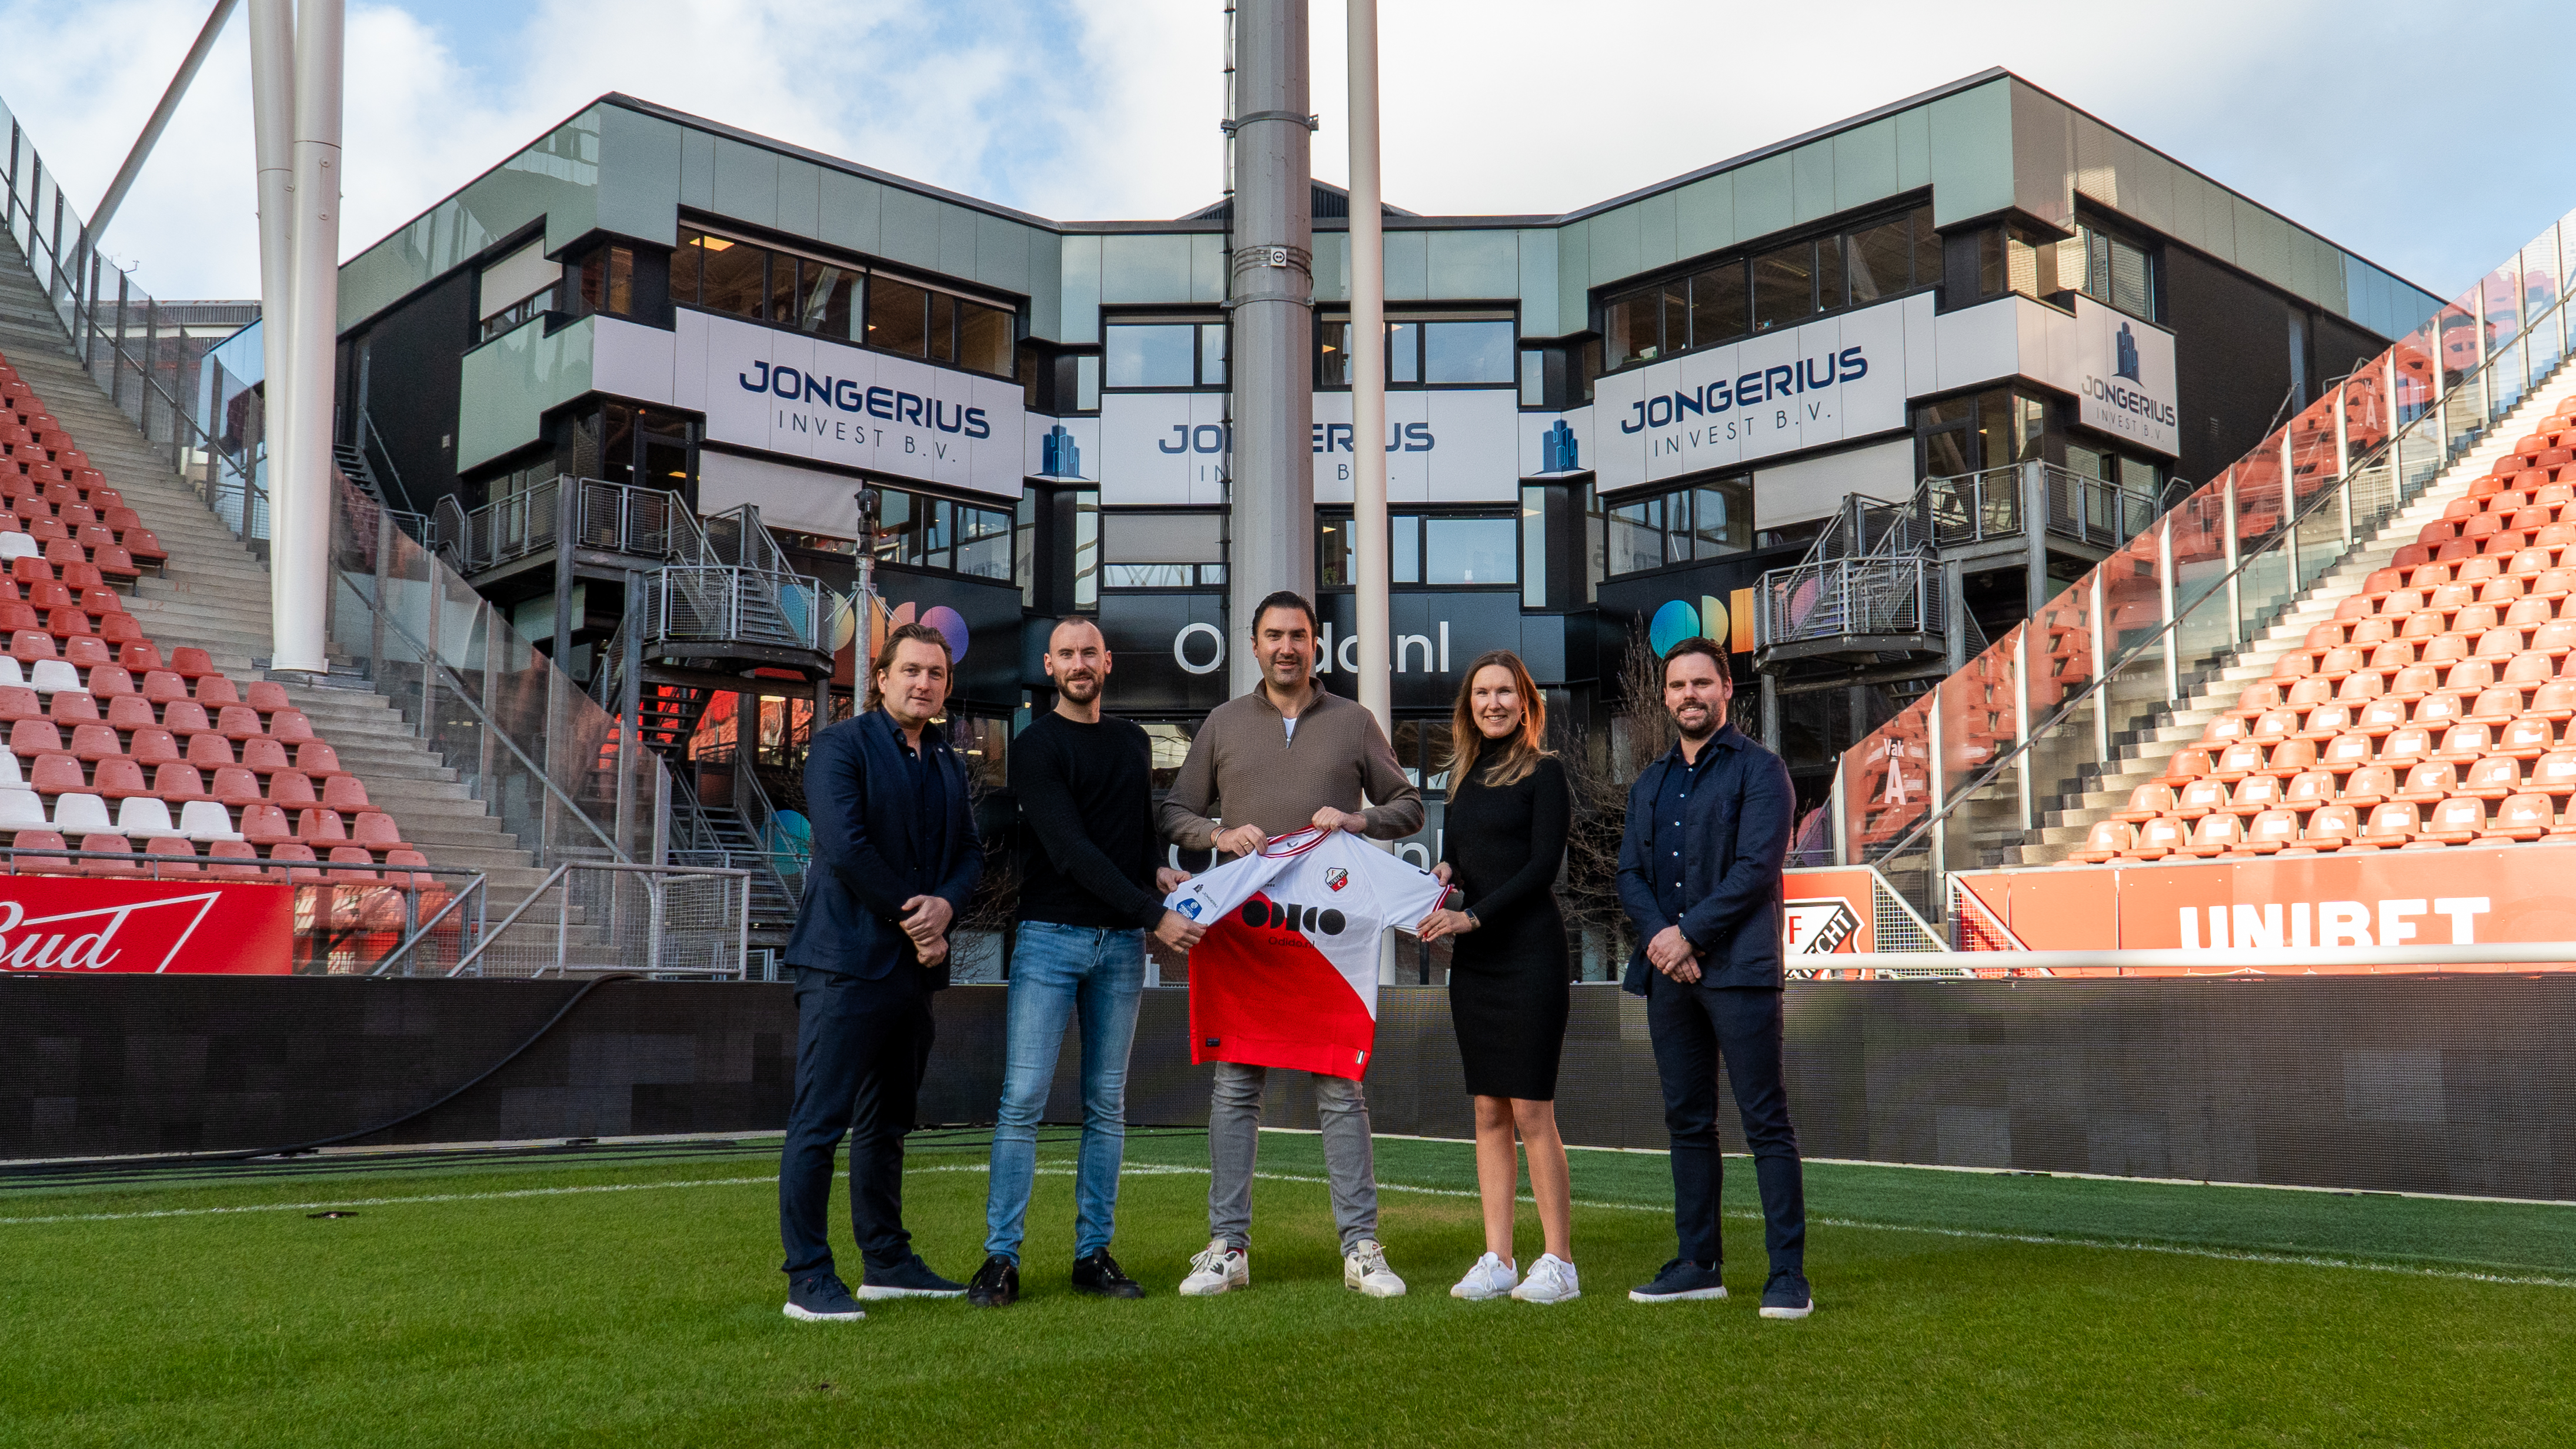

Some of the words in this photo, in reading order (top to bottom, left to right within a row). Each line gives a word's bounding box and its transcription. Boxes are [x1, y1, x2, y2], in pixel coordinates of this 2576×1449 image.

[739, 359, 990, 439] JONGERIUS
[1621, 345, 1868, 434] JONGERIUS
[2082, 375, 2175, 427] JONGERIUS
[779, 410, 883, 448] INVEST
[905, 436, 956, 463] B.V.
[1159, 423, 1435, 454] JORUS
[1654, 417, 1754, 457] INVEST
[1776, 402, 1831, 429] B.V.
[2097, 407, 2136, 432] INVEST
[1884, 738, 1905, 757] Vak
[1884, 759, 1907, 806] A
[1269, 937, 1315, 949] Odido.nl
[1788, 916, 1802, 944] F
[2179, 896, 2491, 948] UNIBET
